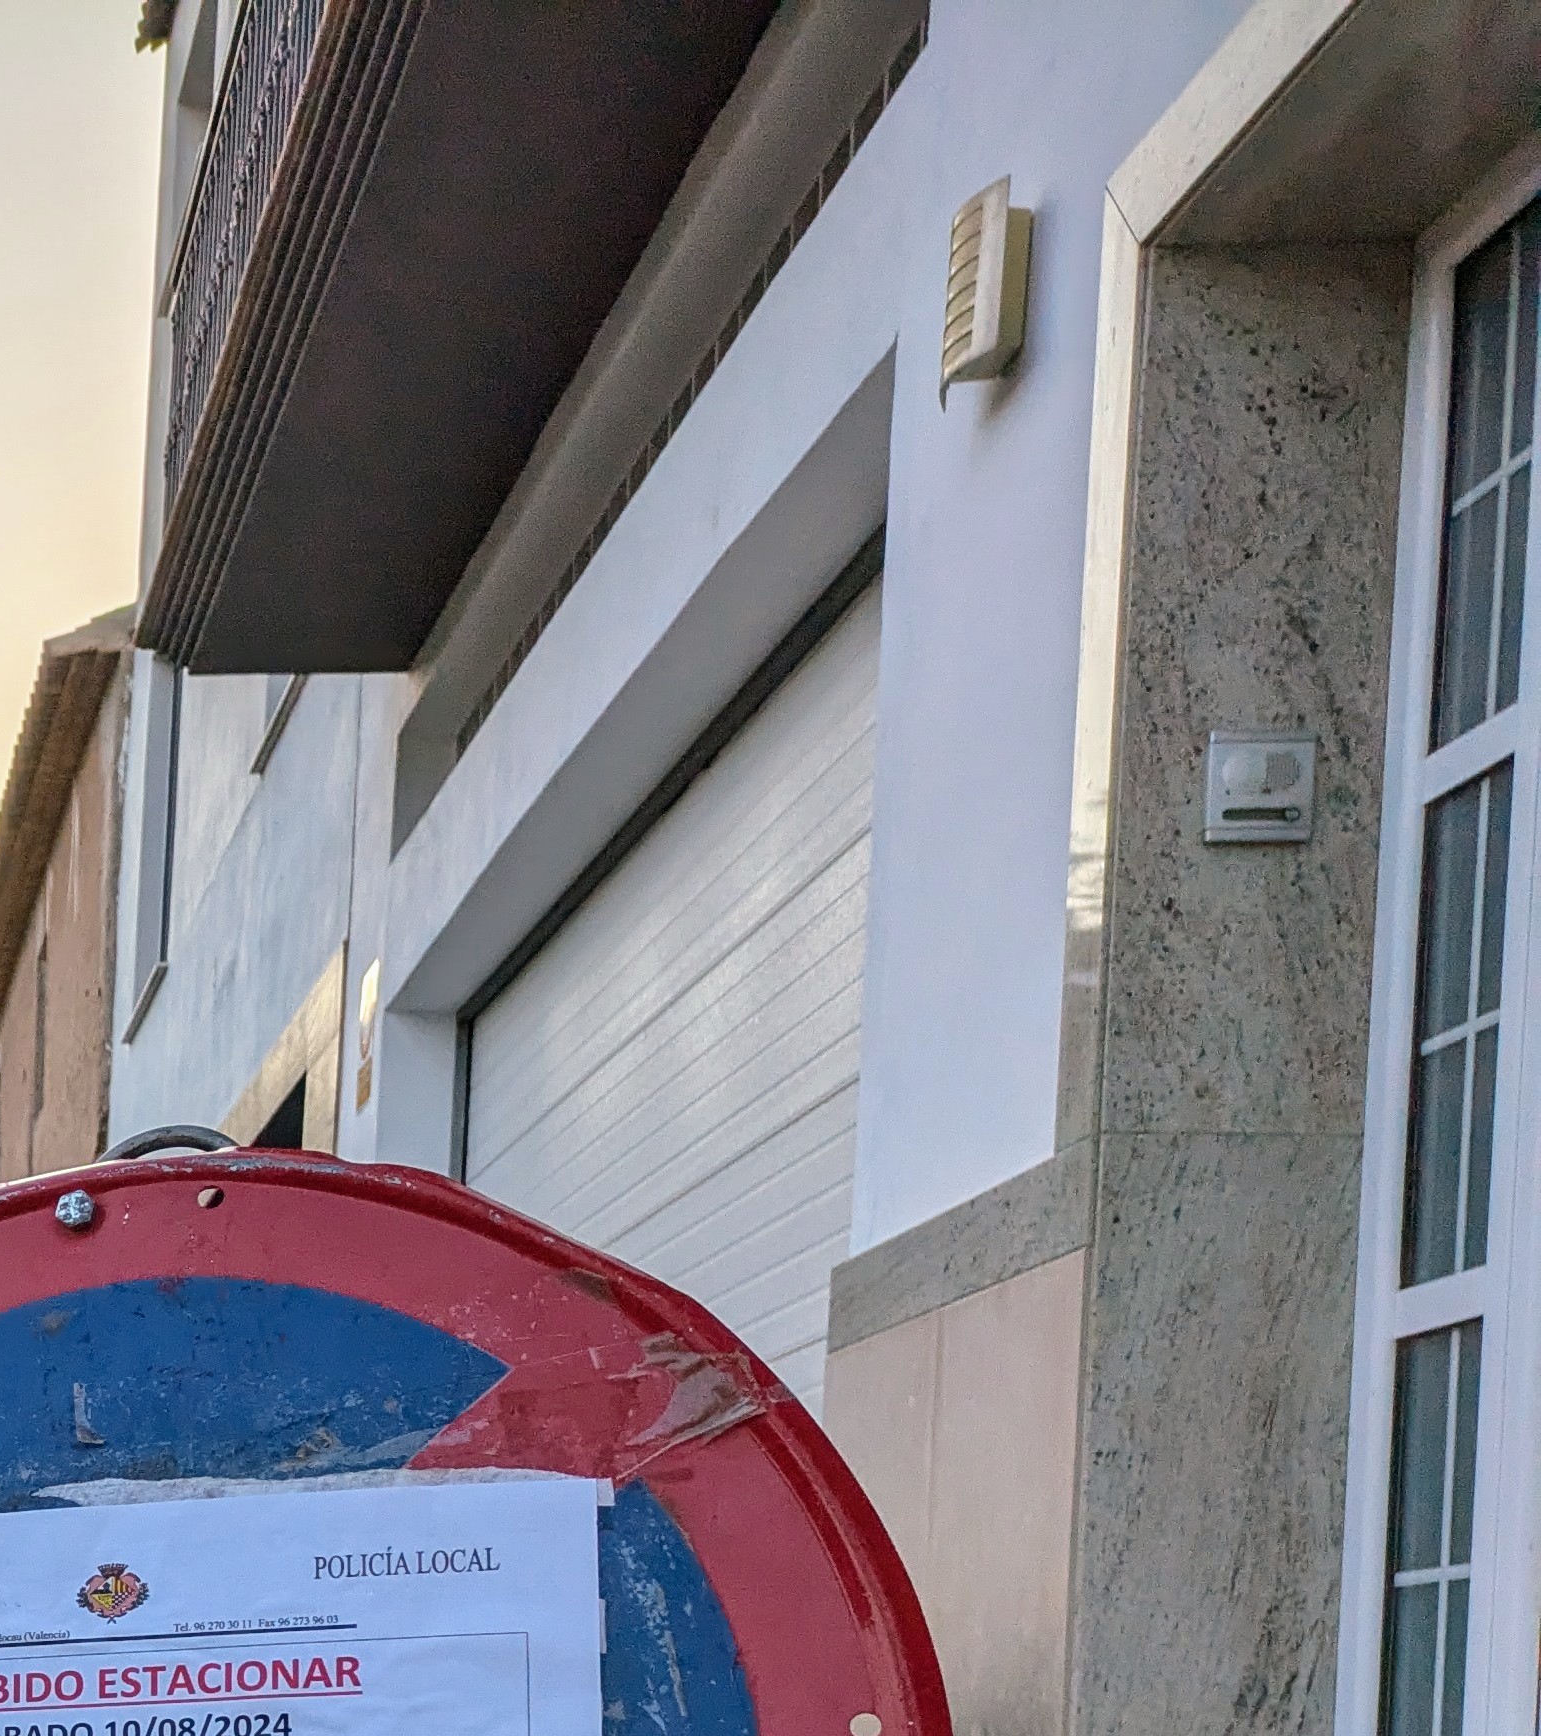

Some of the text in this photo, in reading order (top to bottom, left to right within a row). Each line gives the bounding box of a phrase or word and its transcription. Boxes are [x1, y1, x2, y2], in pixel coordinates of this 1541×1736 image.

[313, 1545, 501, 1580] POLICÍA LOCAL
[173, 1614, 339, 1633] Tel. 96 270 30 11 Fax 96 273 96 03
[98, 1656, 363, 1699] ESTACIONAR
